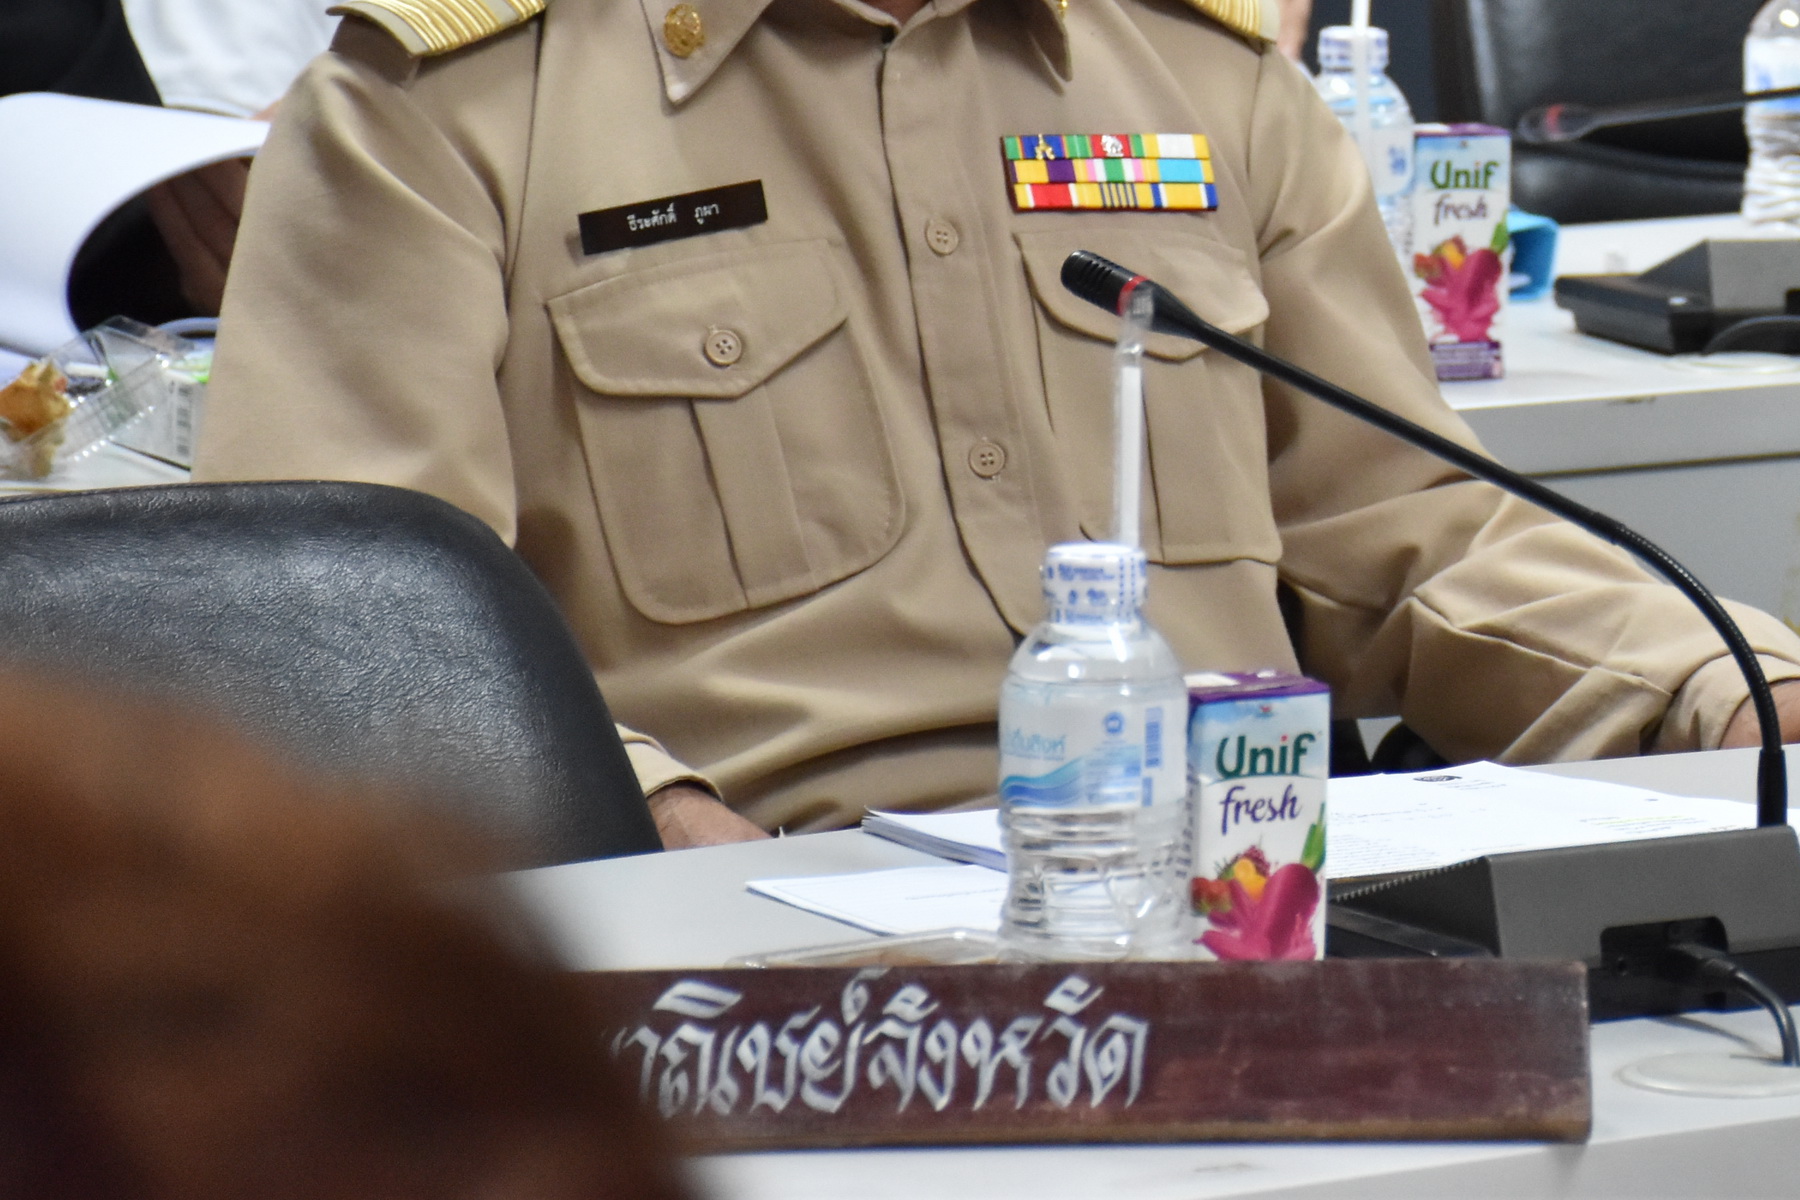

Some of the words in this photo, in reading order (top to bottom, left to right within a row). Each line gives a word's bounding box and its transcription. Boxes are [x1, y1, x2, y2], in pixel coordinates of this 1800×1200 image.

[1430, 159, 1499, 190] Unif
[1433, 193, 1488, 227] fresh
[1215, 730, 1317, 780] Unif
[1219, 783, 1302, 836] fresh
